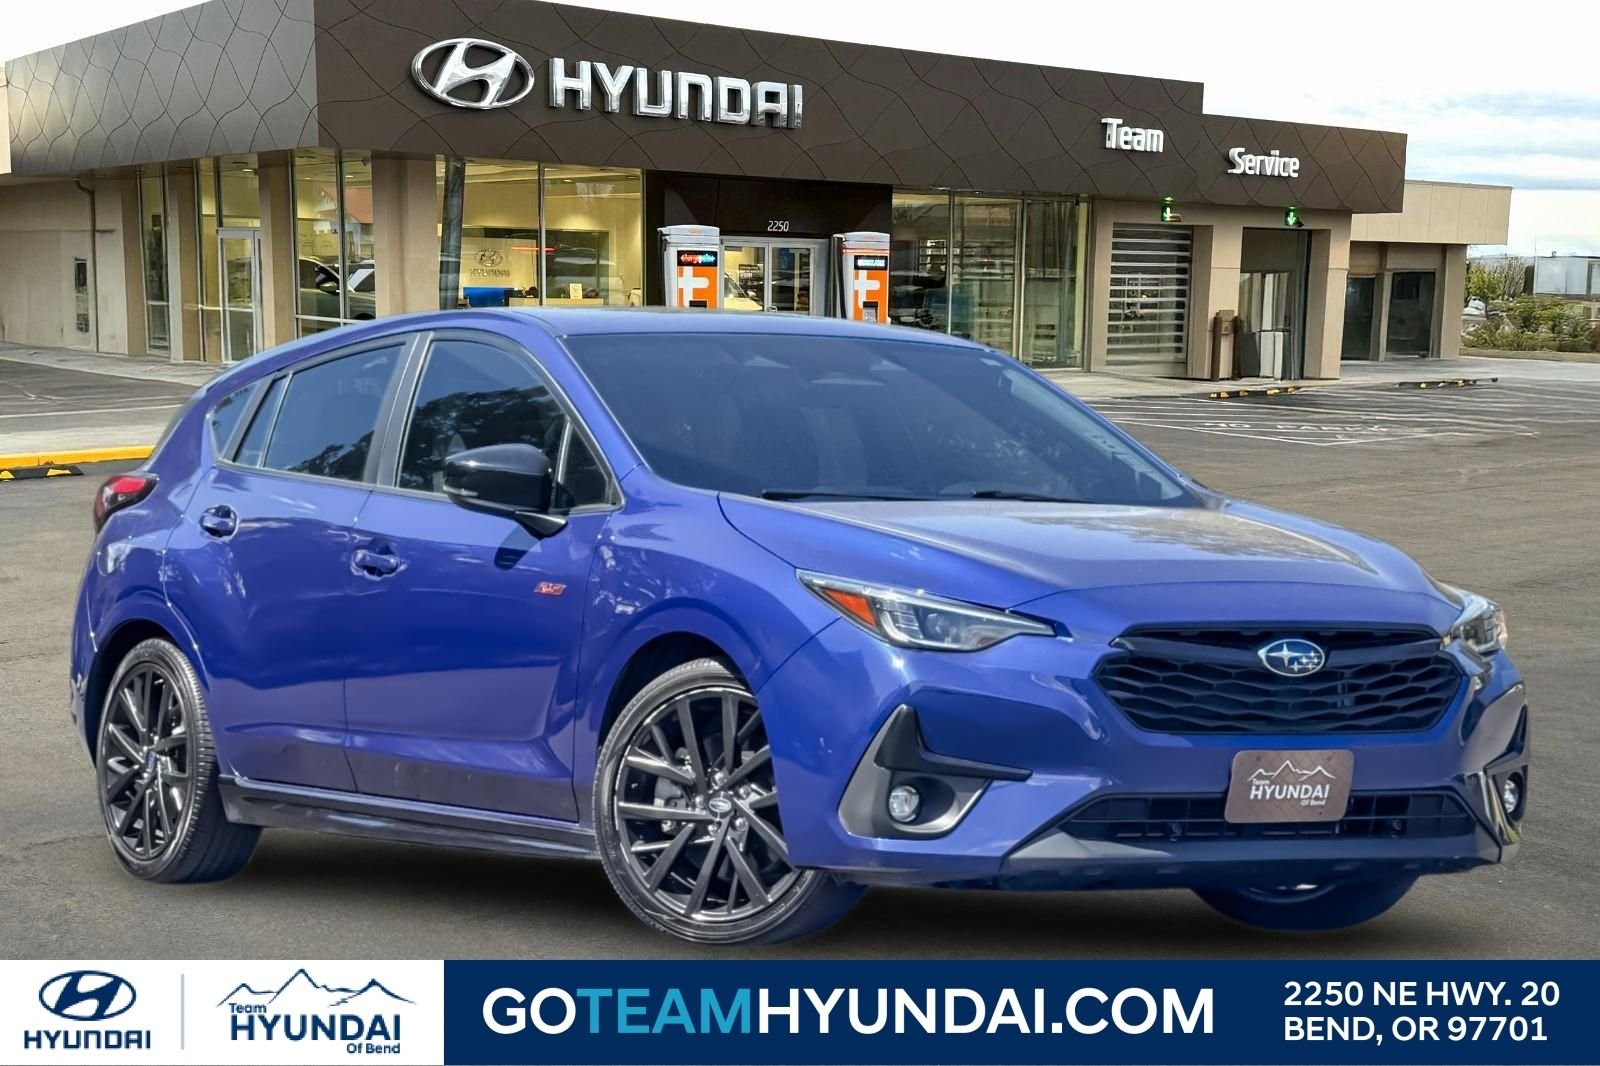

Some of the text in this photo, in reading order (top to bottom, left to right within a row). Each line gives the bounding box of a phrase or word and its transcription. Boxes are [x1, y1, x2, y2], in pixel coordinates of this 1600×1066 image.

[549, 57, 804, 129] HYUNDAI
[1101, 117, 1164, 153] Team
[1227, 147, 1300, 178] Service
[767, 220, 790, 232] 2250
[1250, 784, 1330, 800] HYUNDAI
